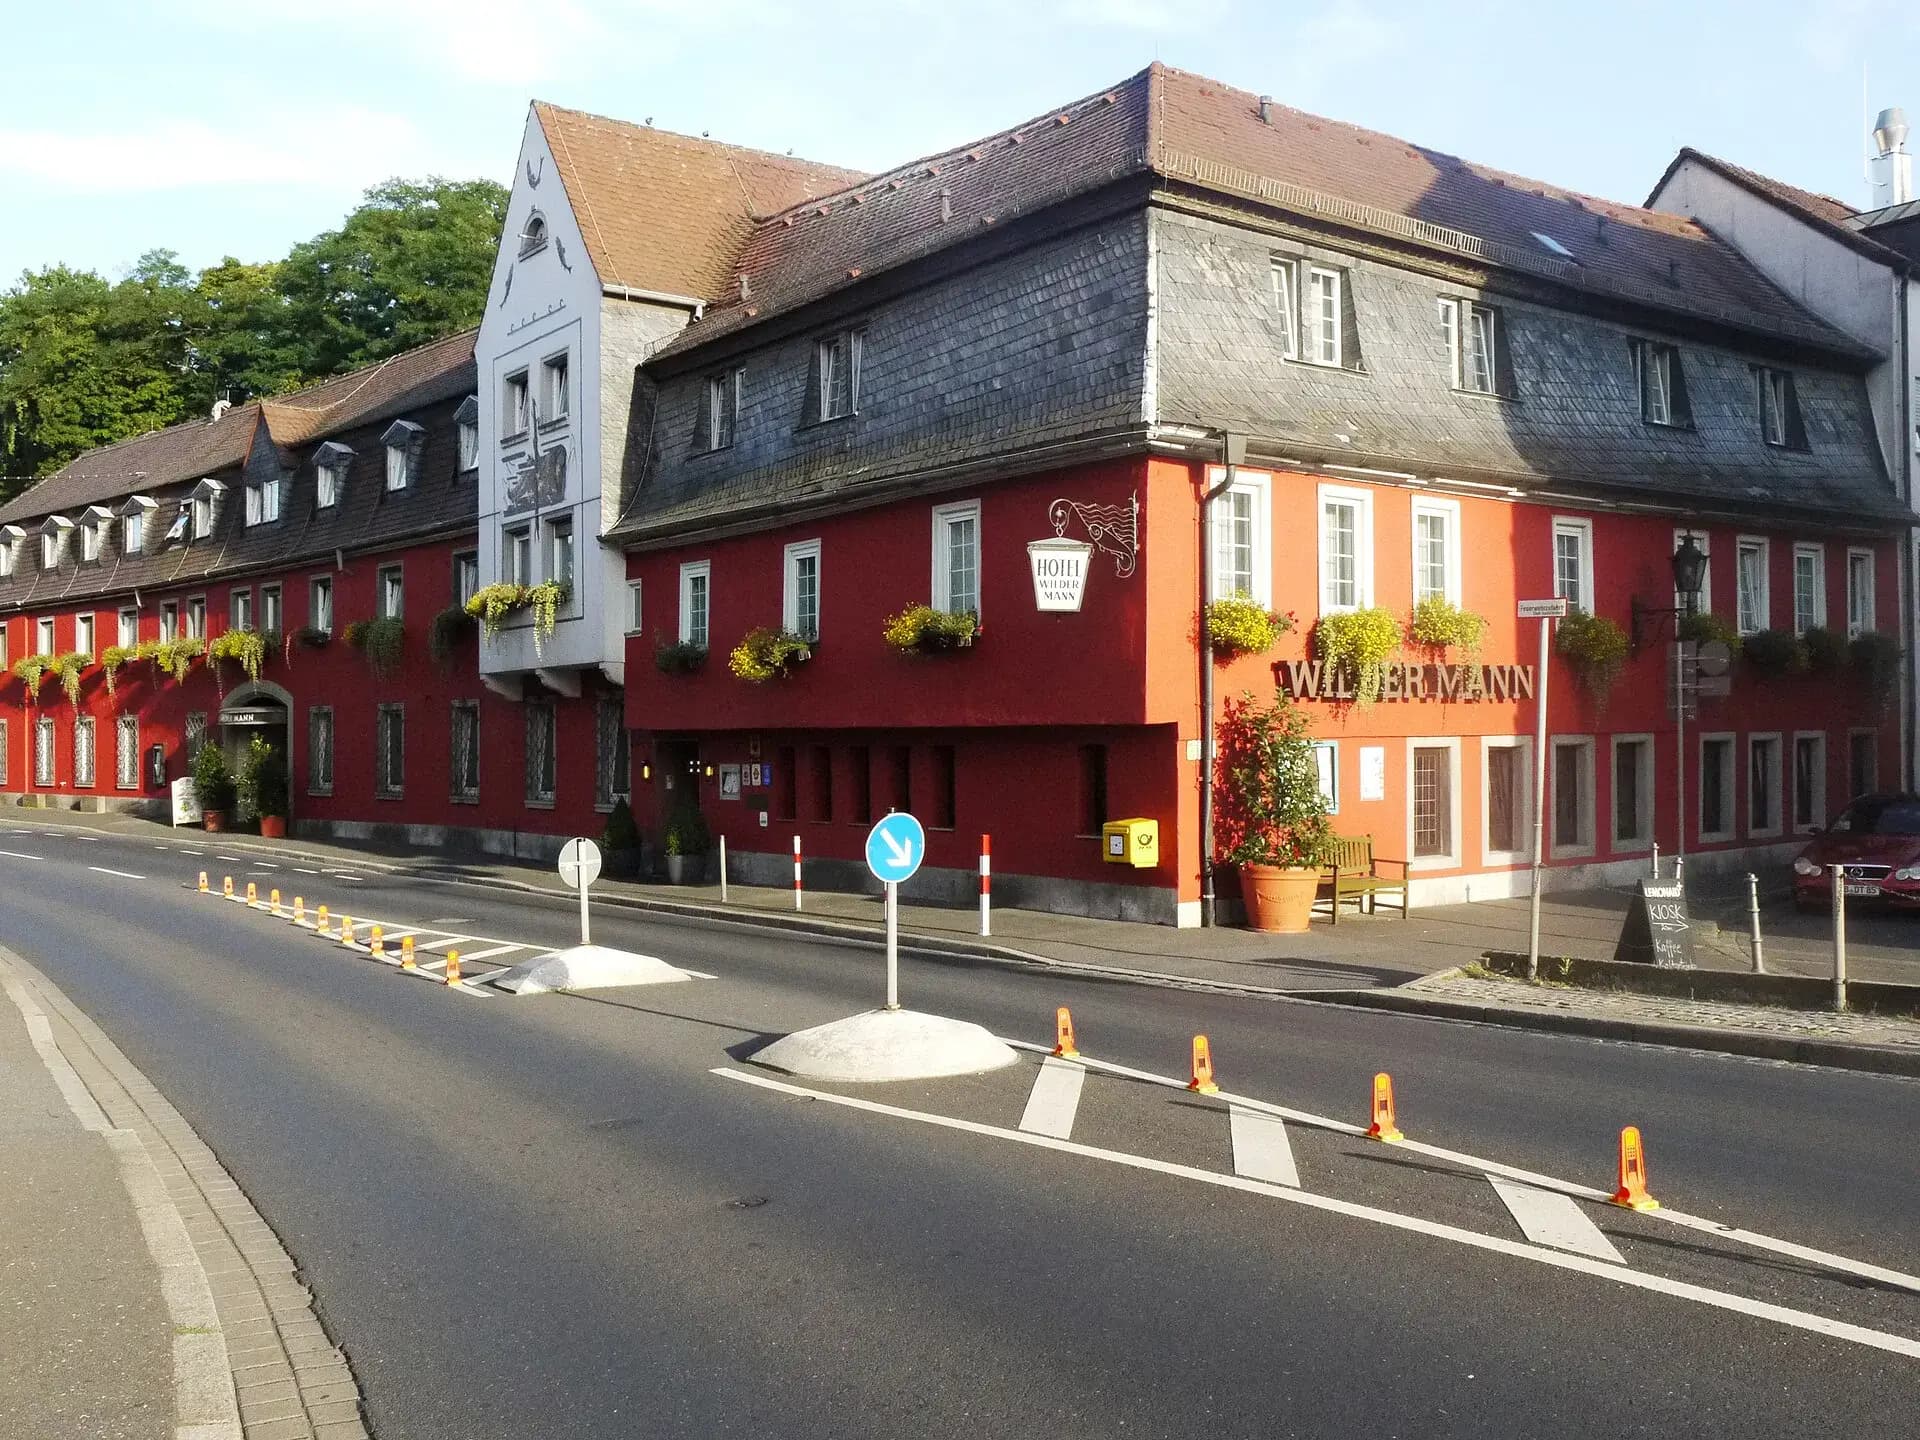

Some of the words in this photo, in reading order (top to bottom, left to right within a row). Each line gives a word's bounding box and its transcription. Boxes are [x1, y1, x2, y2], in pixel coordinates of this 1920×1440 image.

[1037, 558, 1080, 577] HOTEL
[1039, 579, 1079, 589] WILDER
[1043, 591, 1076, 601] MANN
[1286, 659, 1425, 699] WILER
[1435, 663, 1534, 699] MANN
[1649, 904, 1685, 920] KIOSK
[1655, 938, 1682, 958] Kaffee
